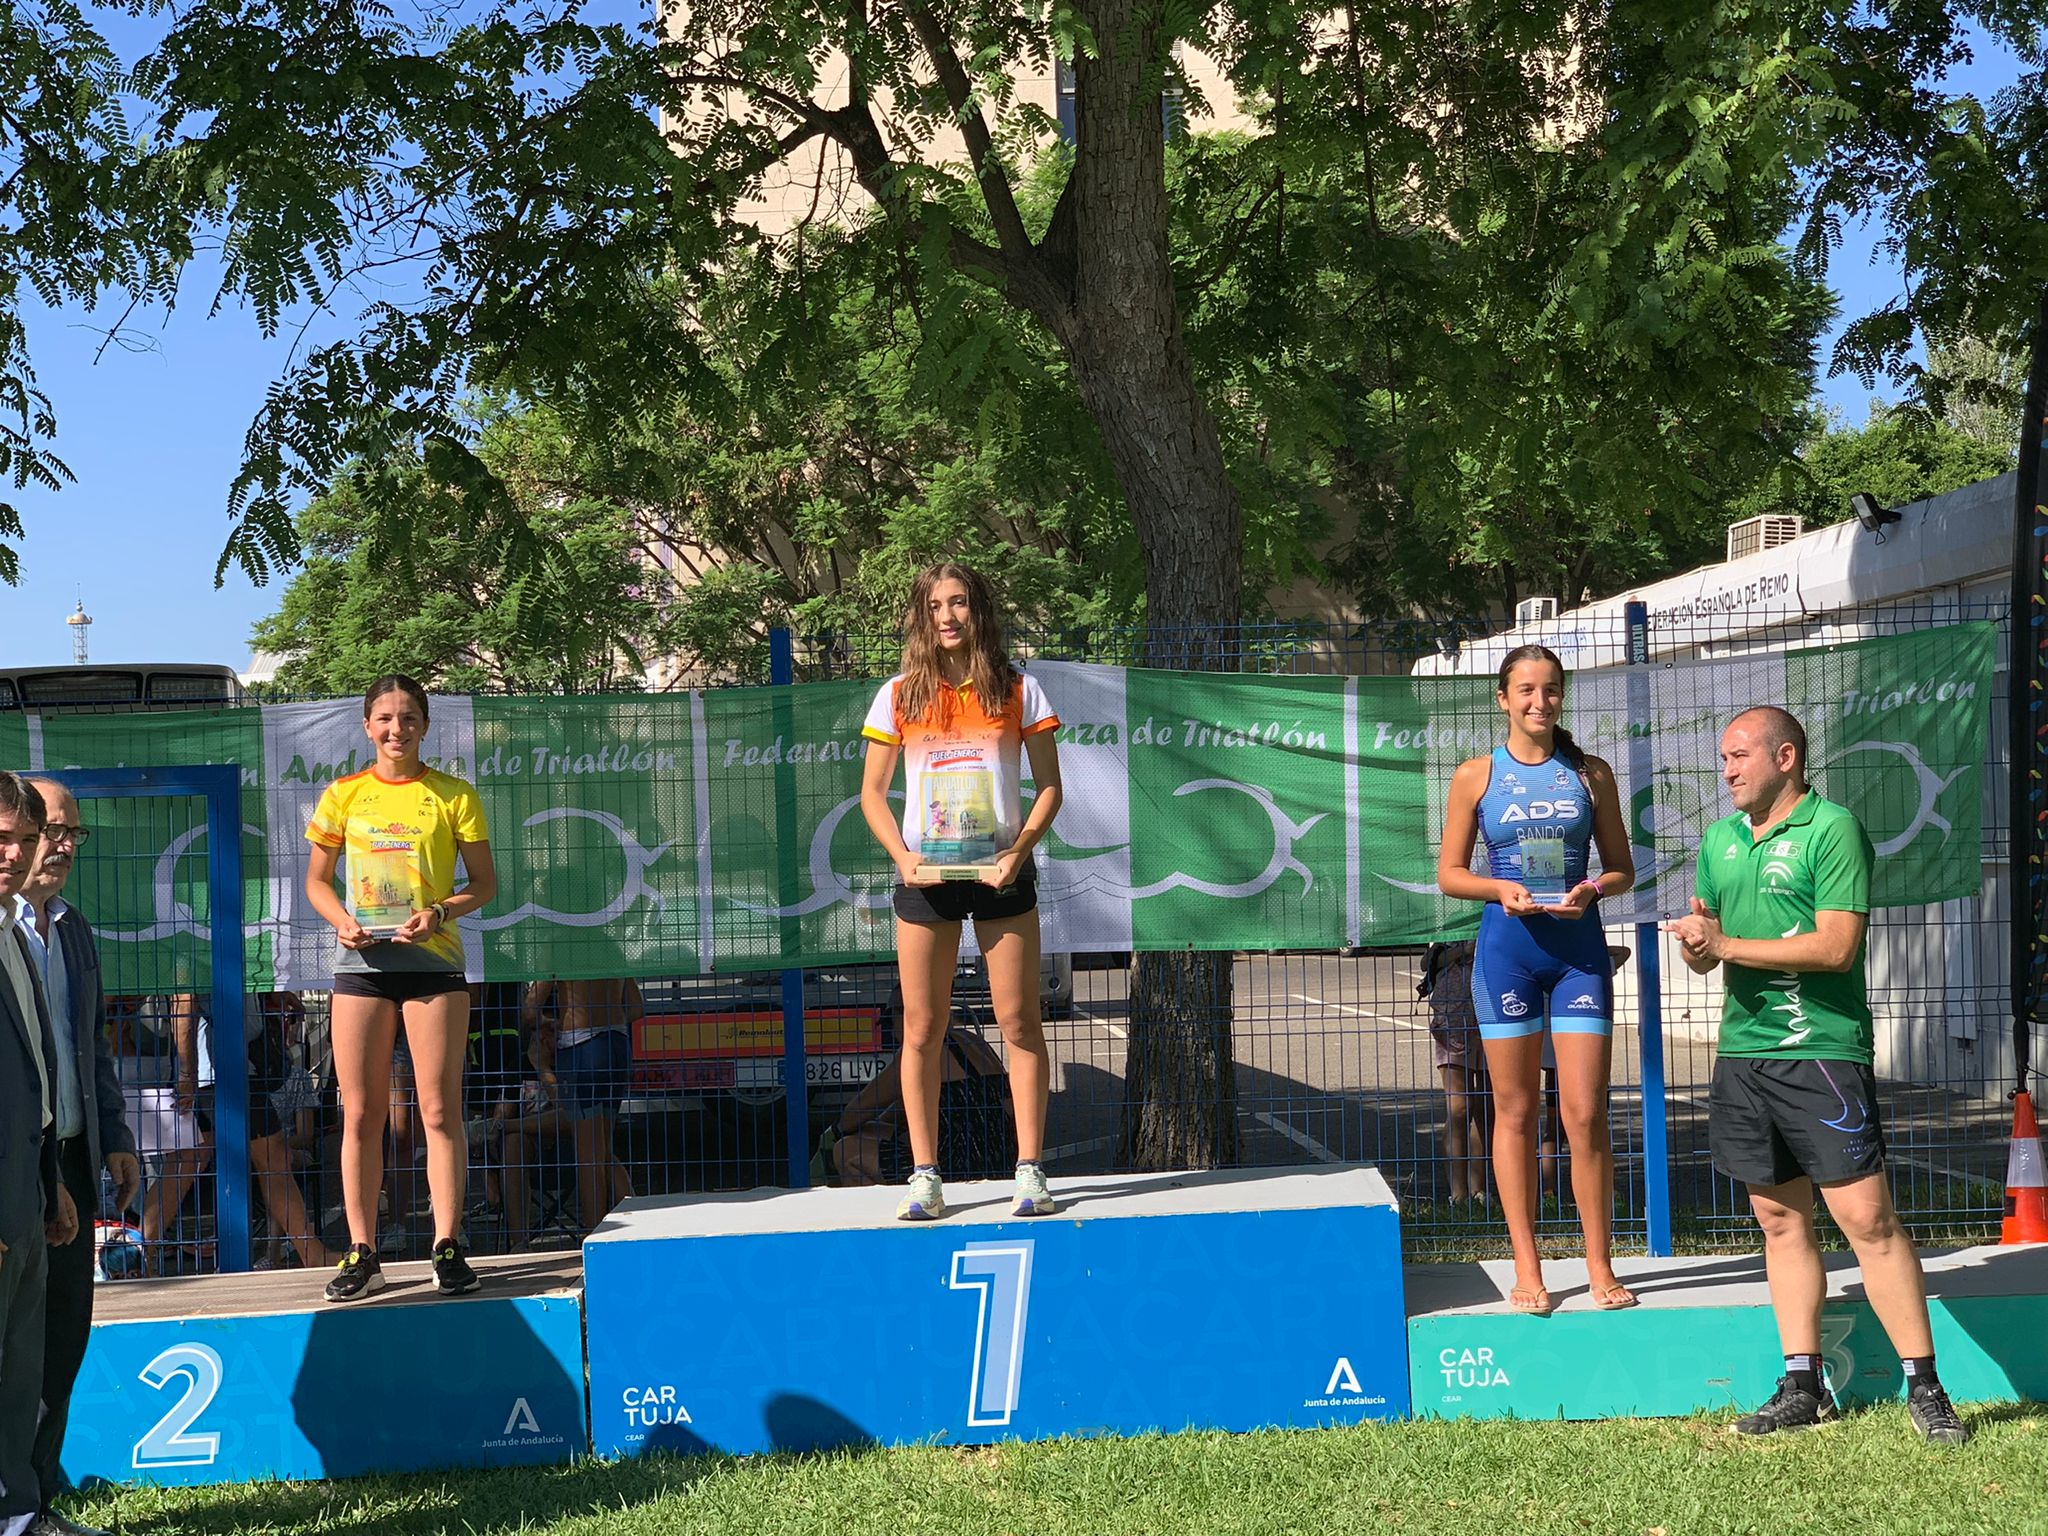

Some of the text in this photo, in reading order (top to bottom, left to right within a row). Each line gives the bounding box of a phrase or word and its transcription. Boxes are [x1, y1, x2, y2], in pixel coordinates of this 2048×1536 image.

[1648, 573, 1789, 630] EDERACIÓN ESPAÑOLA DE REMO
[1631, 624, 1645, 664] ULTRAS
[1842, 671, 1977, 718] Triatlón
[1132, 716, 1173, 746] de
[1182, 719, 1327, 750] Triatlón
[480, 747, 522, 776] de
[531, 741, 675, 776] Triatlón
[723, 735, 867, 768] Federaci
[1498, 800, 1580, 825] ADS
[806, 1062, 842, 1080] 826
[949, 1239, 1036, 1427] 1
[1439, 1347, 1494, 1367] CAR
[1440, 1367, 1511, 1388] TUJA
[132, 1341, 224, 1469] 2
[622, 1385, 677, 1407] CAR
[1303, 1394, 1386, 1407] Junta de Andalucía
[623, 1405, 693, 1427] TUJA
[482, 1434, 564, 1449] Junta de Andalucía
[624, 1434, 645, 1442] CEAR
